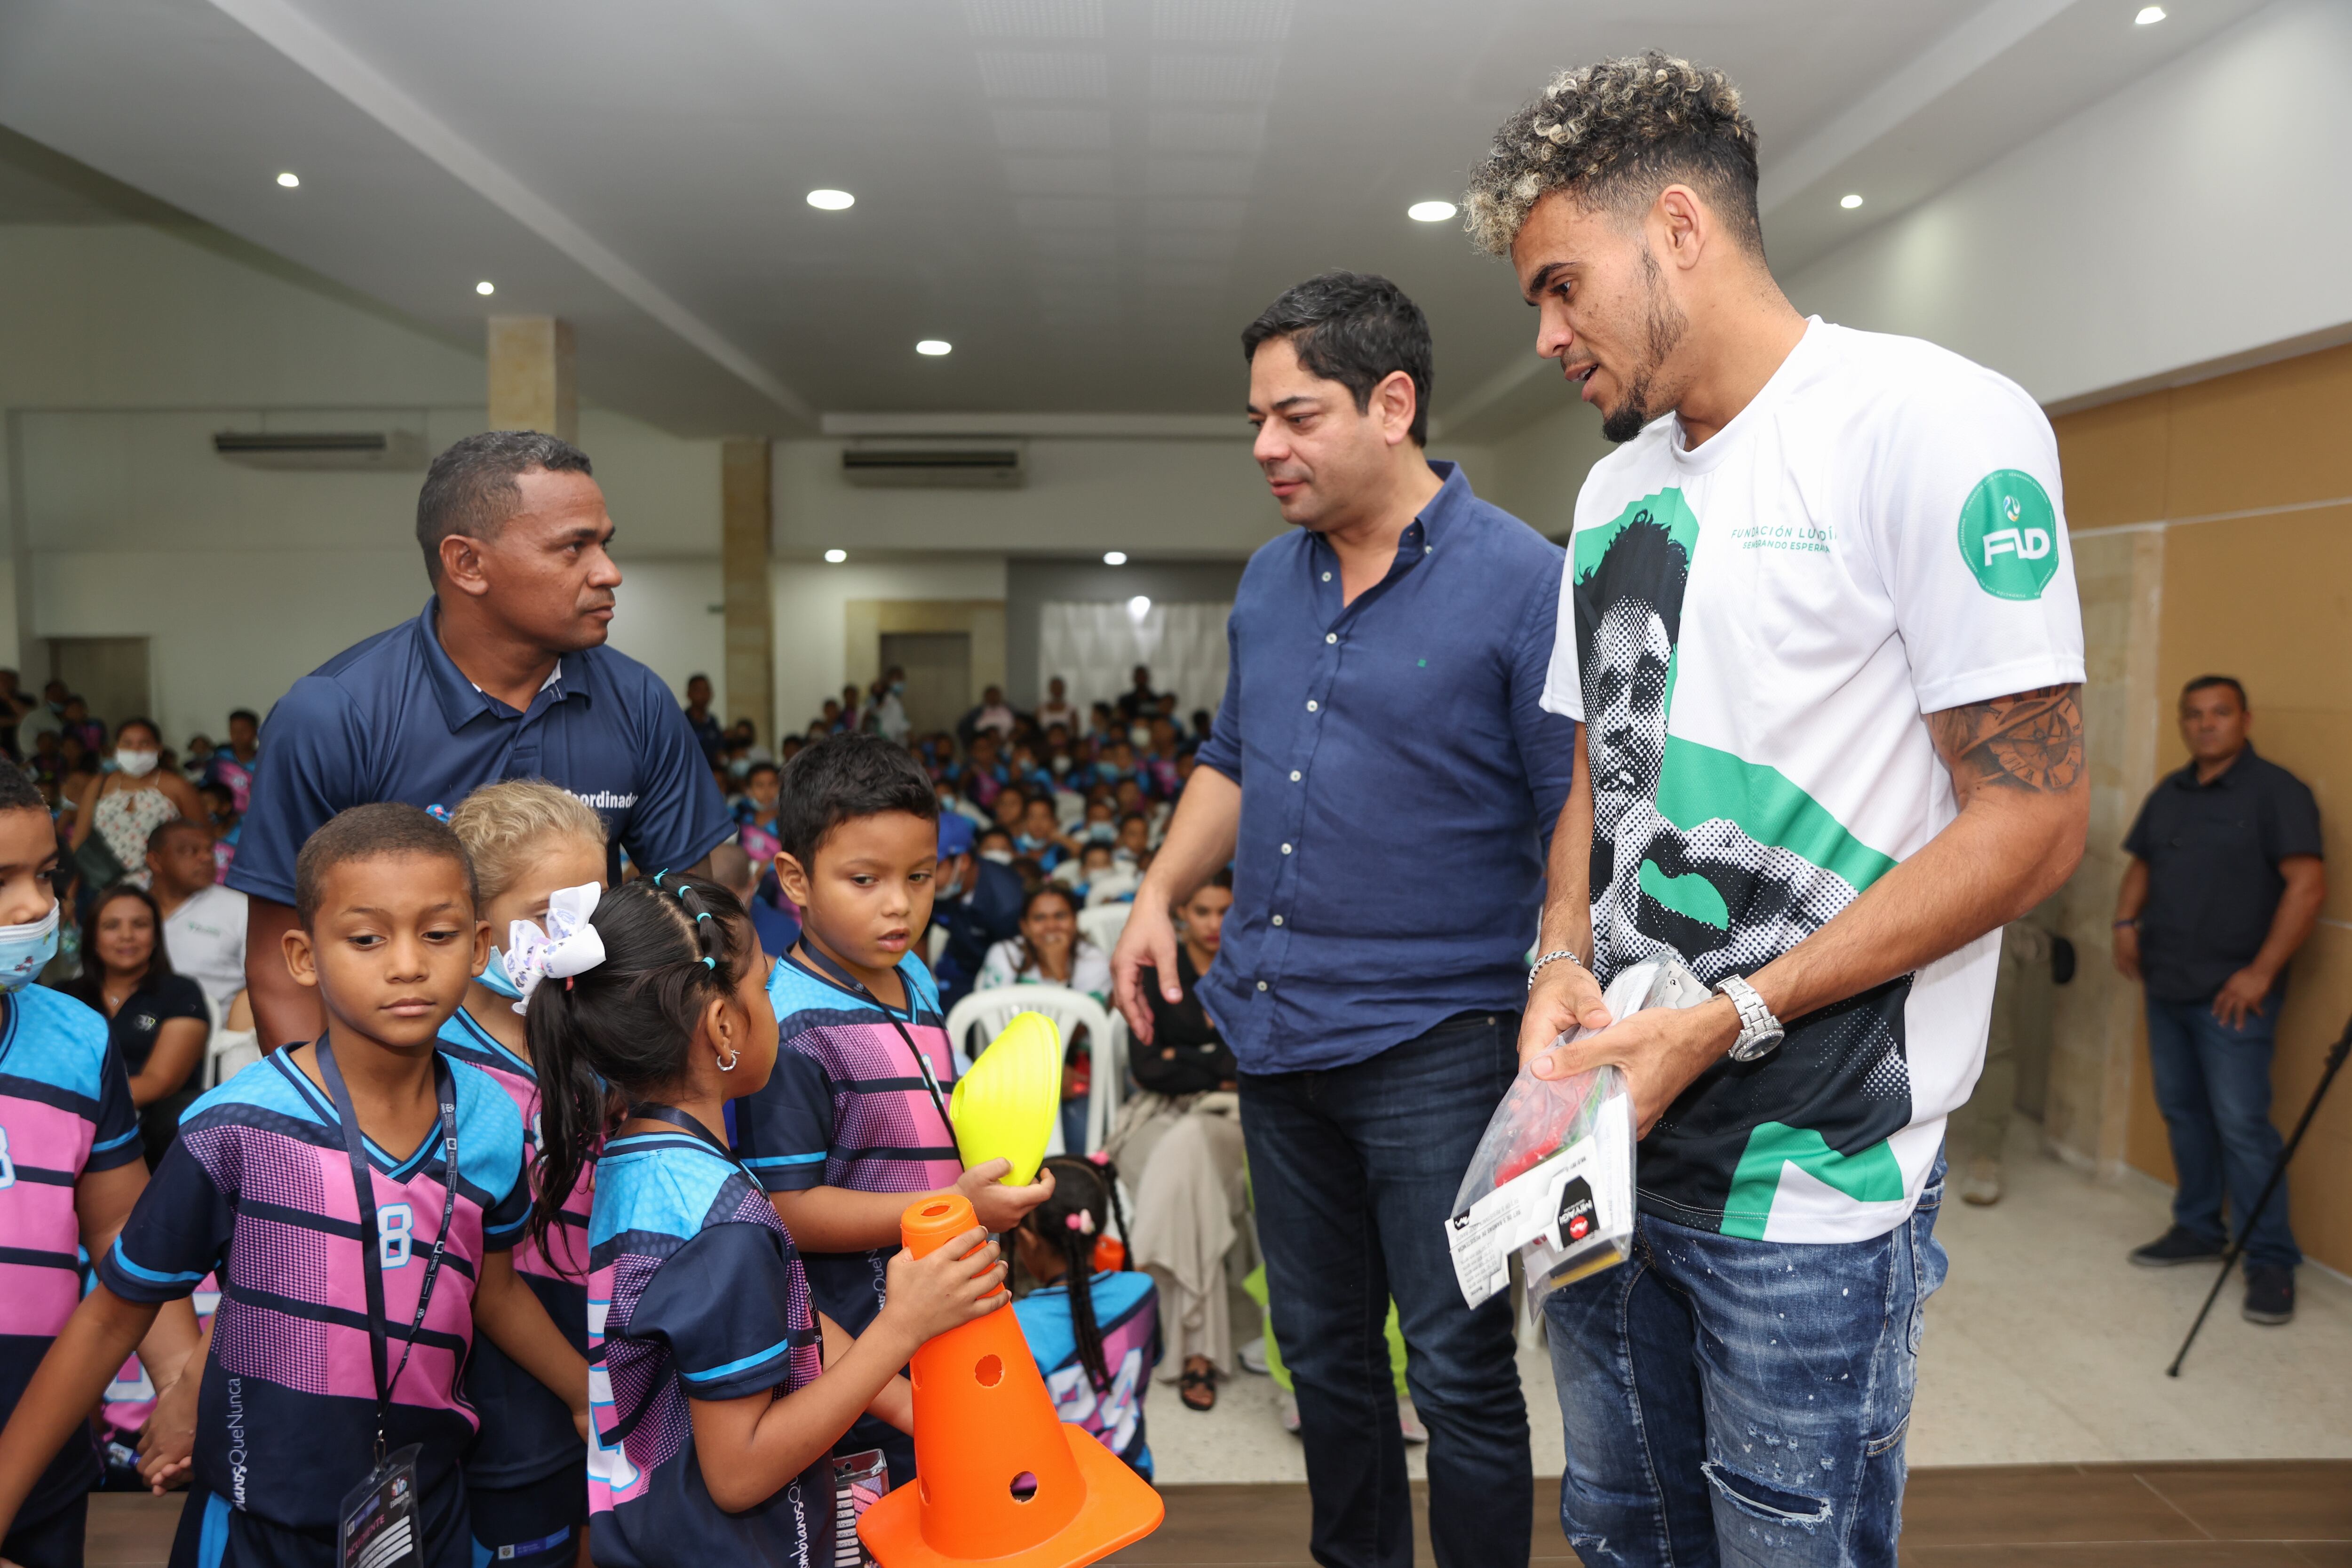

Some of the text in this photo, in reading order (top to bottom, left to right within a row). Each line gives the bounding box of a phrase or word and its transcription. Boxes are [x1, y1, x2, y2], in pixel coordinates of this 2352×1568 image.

[1731, 525, 1793, 539] FUNDACIÓN
[1742, 540, 1787, 549] SEMBRANDO
[1559, 1199, 1593, 1225] MIYAGI
[377, 1202, 413, 1269] 8
[346, 1513, 385, 1559] ACUDIENTE
